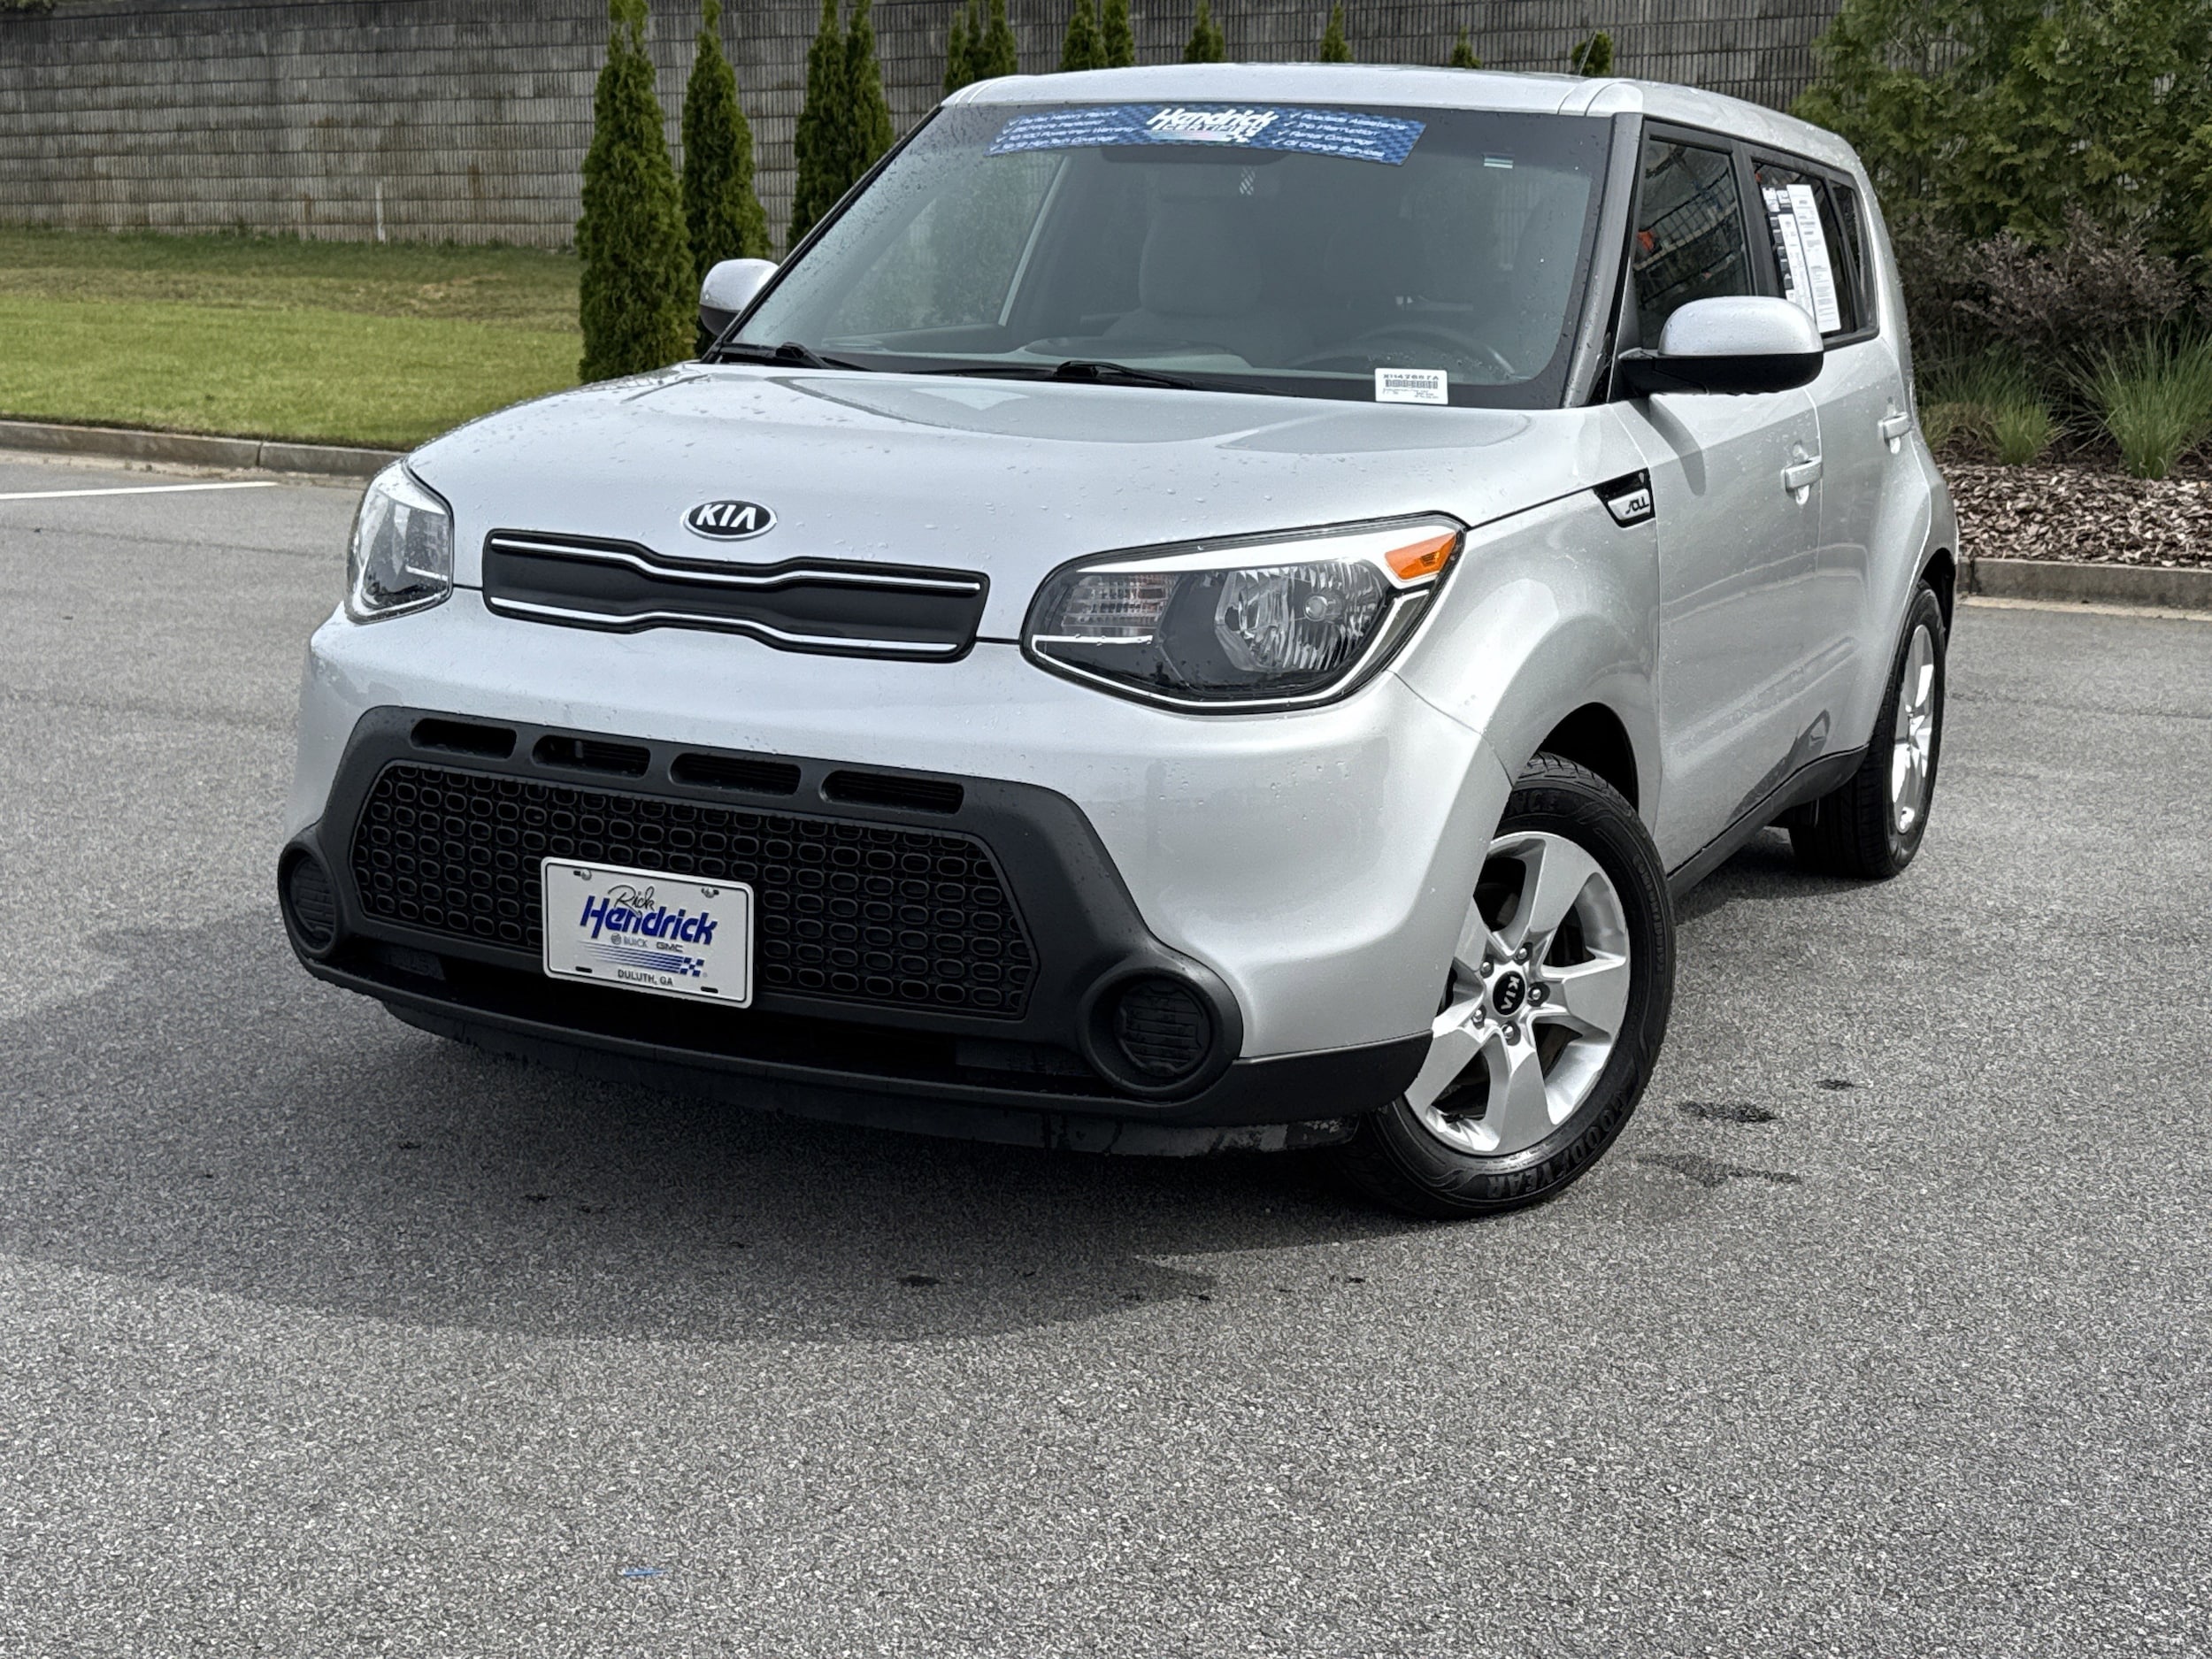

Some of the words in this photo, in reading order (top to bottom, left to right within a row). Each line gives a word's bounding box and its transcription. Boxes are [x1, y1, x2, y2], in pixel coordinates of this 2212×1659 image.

[1146, 108, 1279, 131] Hendrick
[695, 503, 757, 530] KIA
[608, 884, 657, 918] Rick
[580, 895, 718, 946] Hendrick
[623, 935, 649, 949] BUICK
[656, 941, 684, 953] GMC
[618, 969, 658, 986] DULUTH,
[1500, 976, 1521, 1010] KIA
